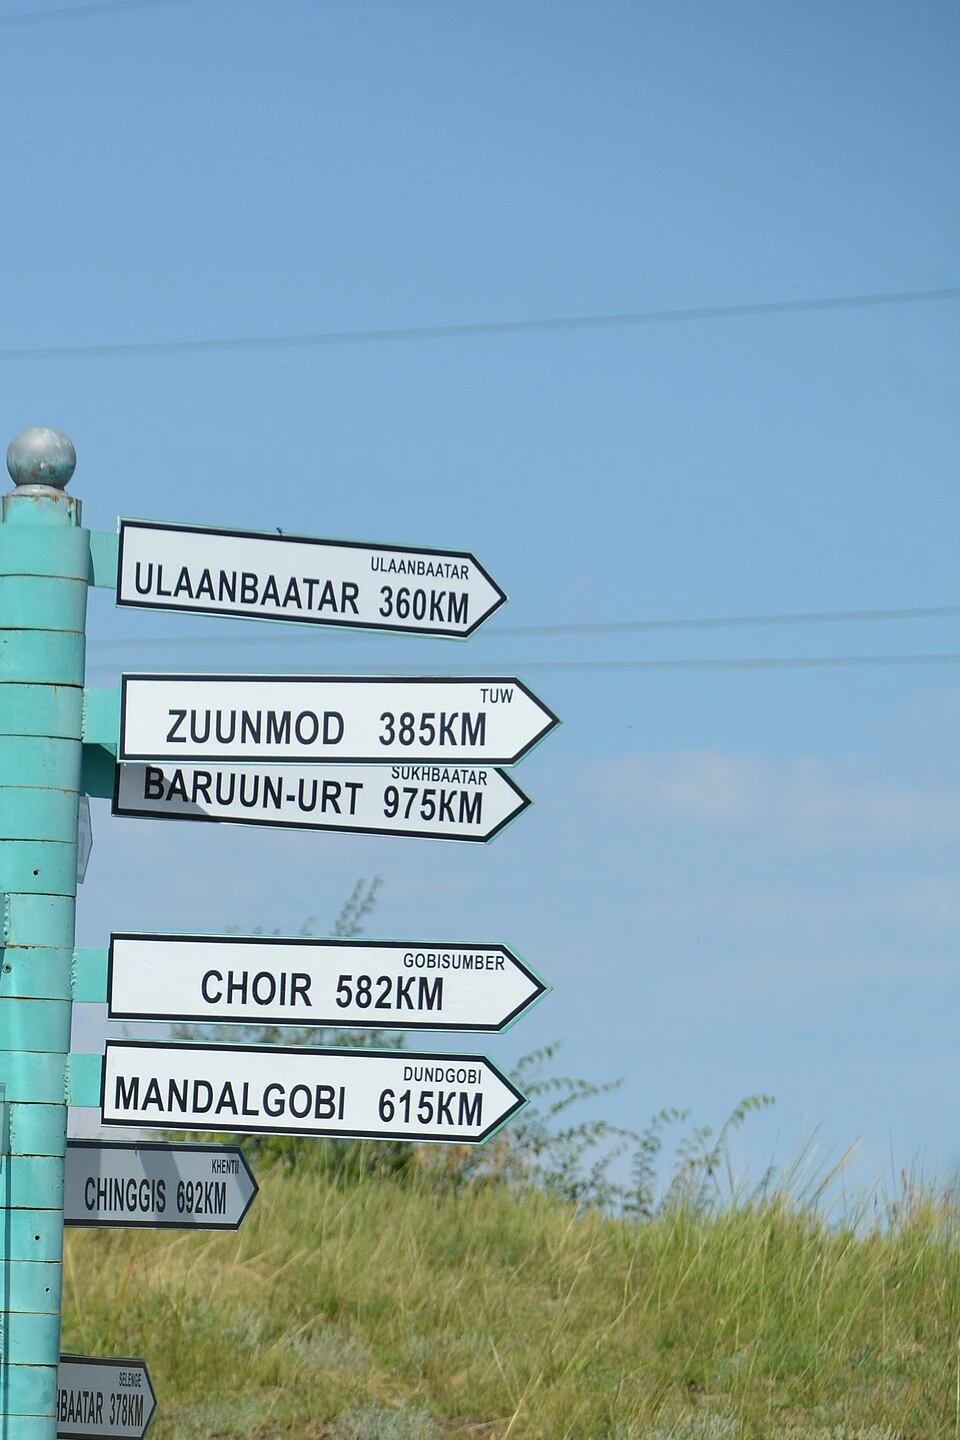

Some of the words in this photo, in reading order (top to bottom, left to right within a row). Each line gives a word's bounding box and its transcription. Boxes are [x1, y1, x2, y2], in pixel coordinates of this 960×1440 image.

[371, 556, 470, 580] ULAANBAATAR
[134, 562, 360, 614] ULAANBAATAR
[379, 585, 469, 624] 360KM
[480, 689, 514, 704] TUW
[166, 709, 345, 745] ZUUNMOD
[379, 711, 487, 746] 385KM
[391, 767, 487, 785] SUKHBAATAR
[143, 766, 363, 815] BARUUN-URT
[383, 785, 483, 824] 975KM
[403, 953, 505, 971] GOBISUMBER
[201, 969, 312, 1007] CHOIR
[336, 974, 444, 1011] 582KM
[403, 1066, 482, 1084] DUNDGOBI
[115, 1076, 345, 1120] MANDALGOBI
[378, 1089, 483, 1127] 615KM
[84, 1176, 166, 1214] CHINGGIS
[176, 1179, 226, 1215] 692KM
[110, 1393, 144, 1427] 378KM
